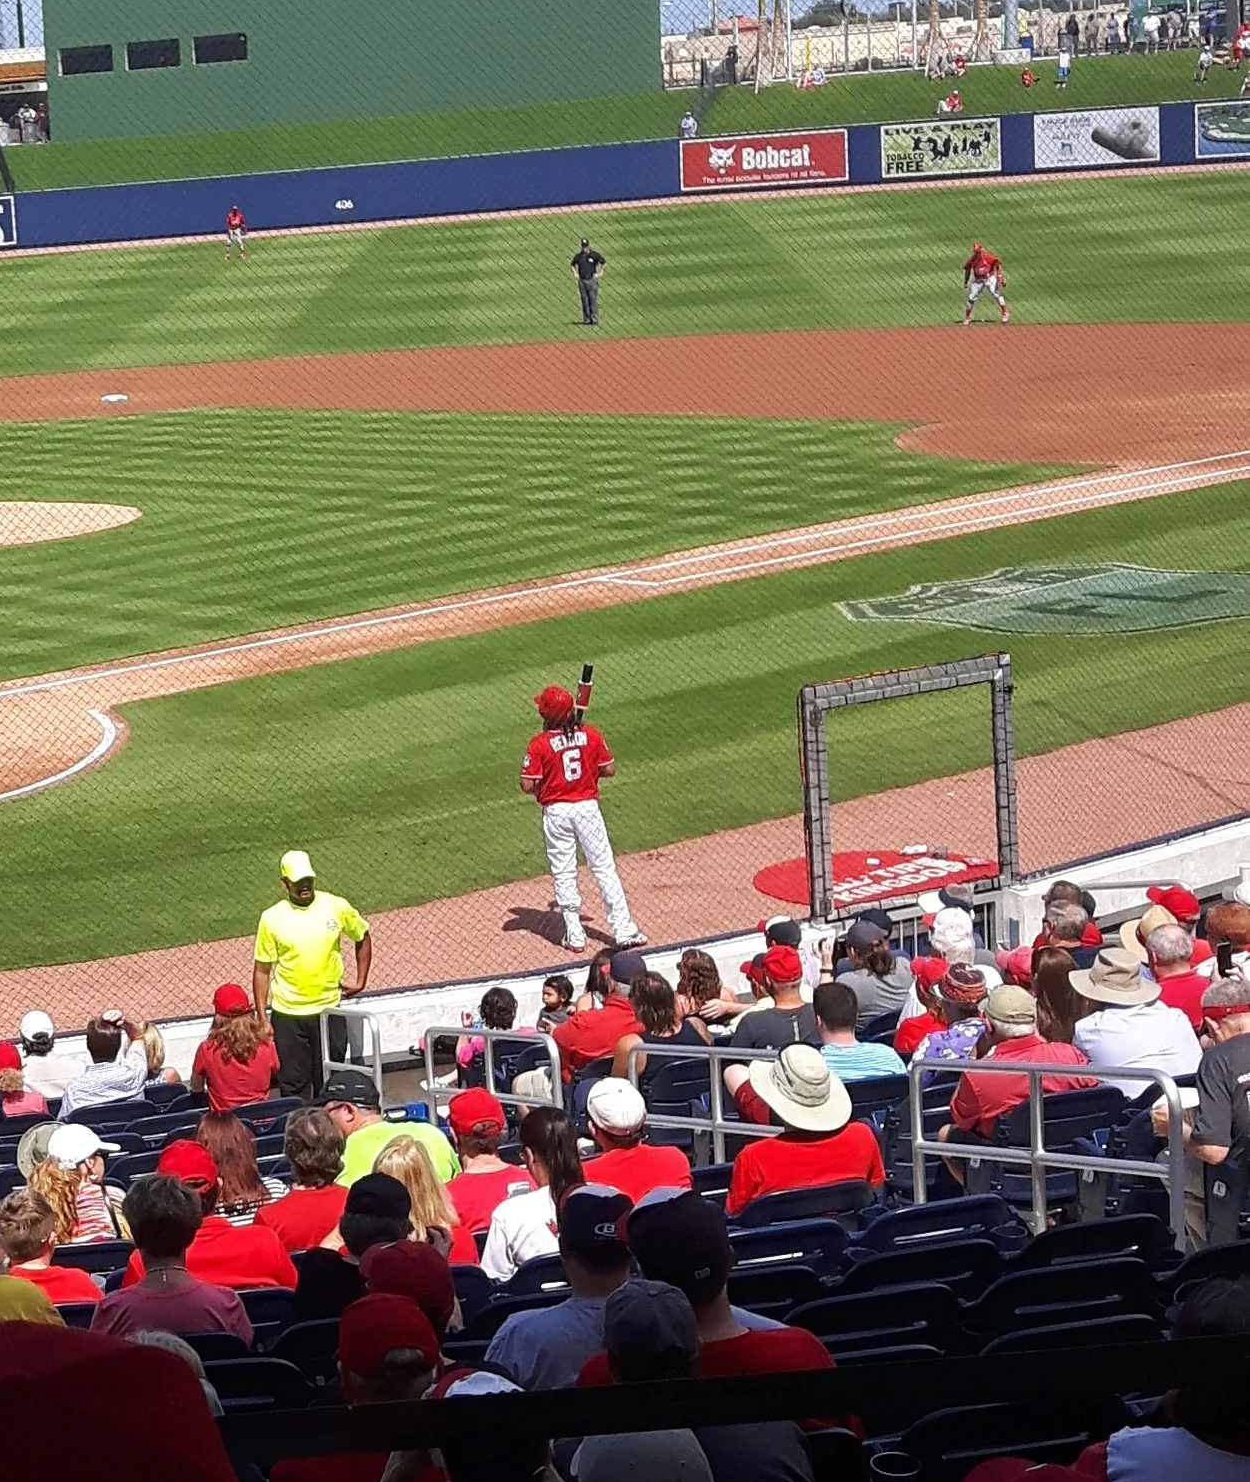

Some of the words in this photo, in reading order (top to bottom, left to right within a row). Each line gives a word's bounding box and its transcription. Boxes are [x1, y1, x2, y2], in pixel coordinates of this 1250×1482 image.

[884, 126, 925, 136] LIVE
[950, 122, 994, 131] PLAY
[742, 144, 811, 170] Bobcat
[886, 152, 925, 162] TOBACCO
[886, 160, 925, 174] FREE
[335, 199, 354, 209] 406
[562, 748, 582, 782] 6
